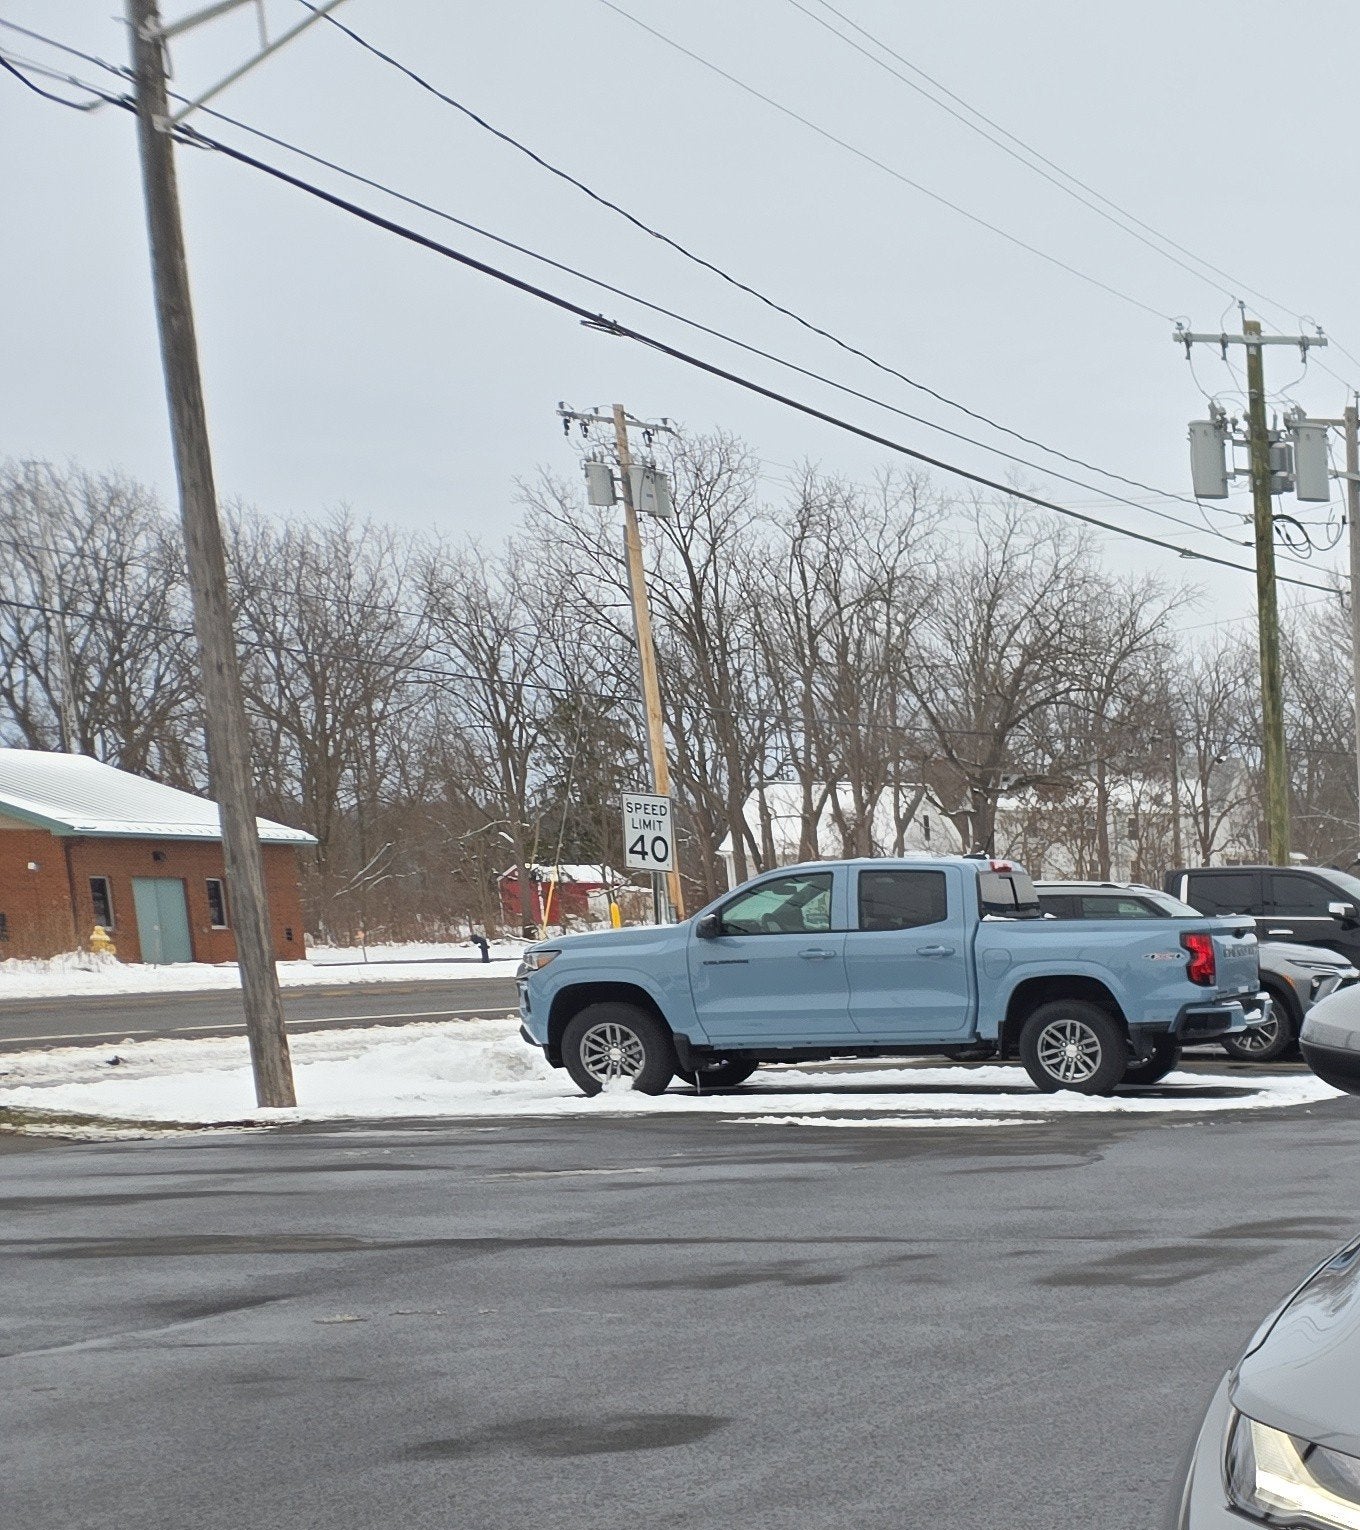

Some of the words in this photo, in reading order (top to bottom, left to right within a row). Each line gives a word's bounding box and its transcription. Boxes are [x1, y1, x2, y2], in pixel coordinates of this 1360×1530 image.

[626, 801, 668, 817] SPEED
[631, 818, 663, 831] LIMIT
[628, 834, 669, 863] 40
